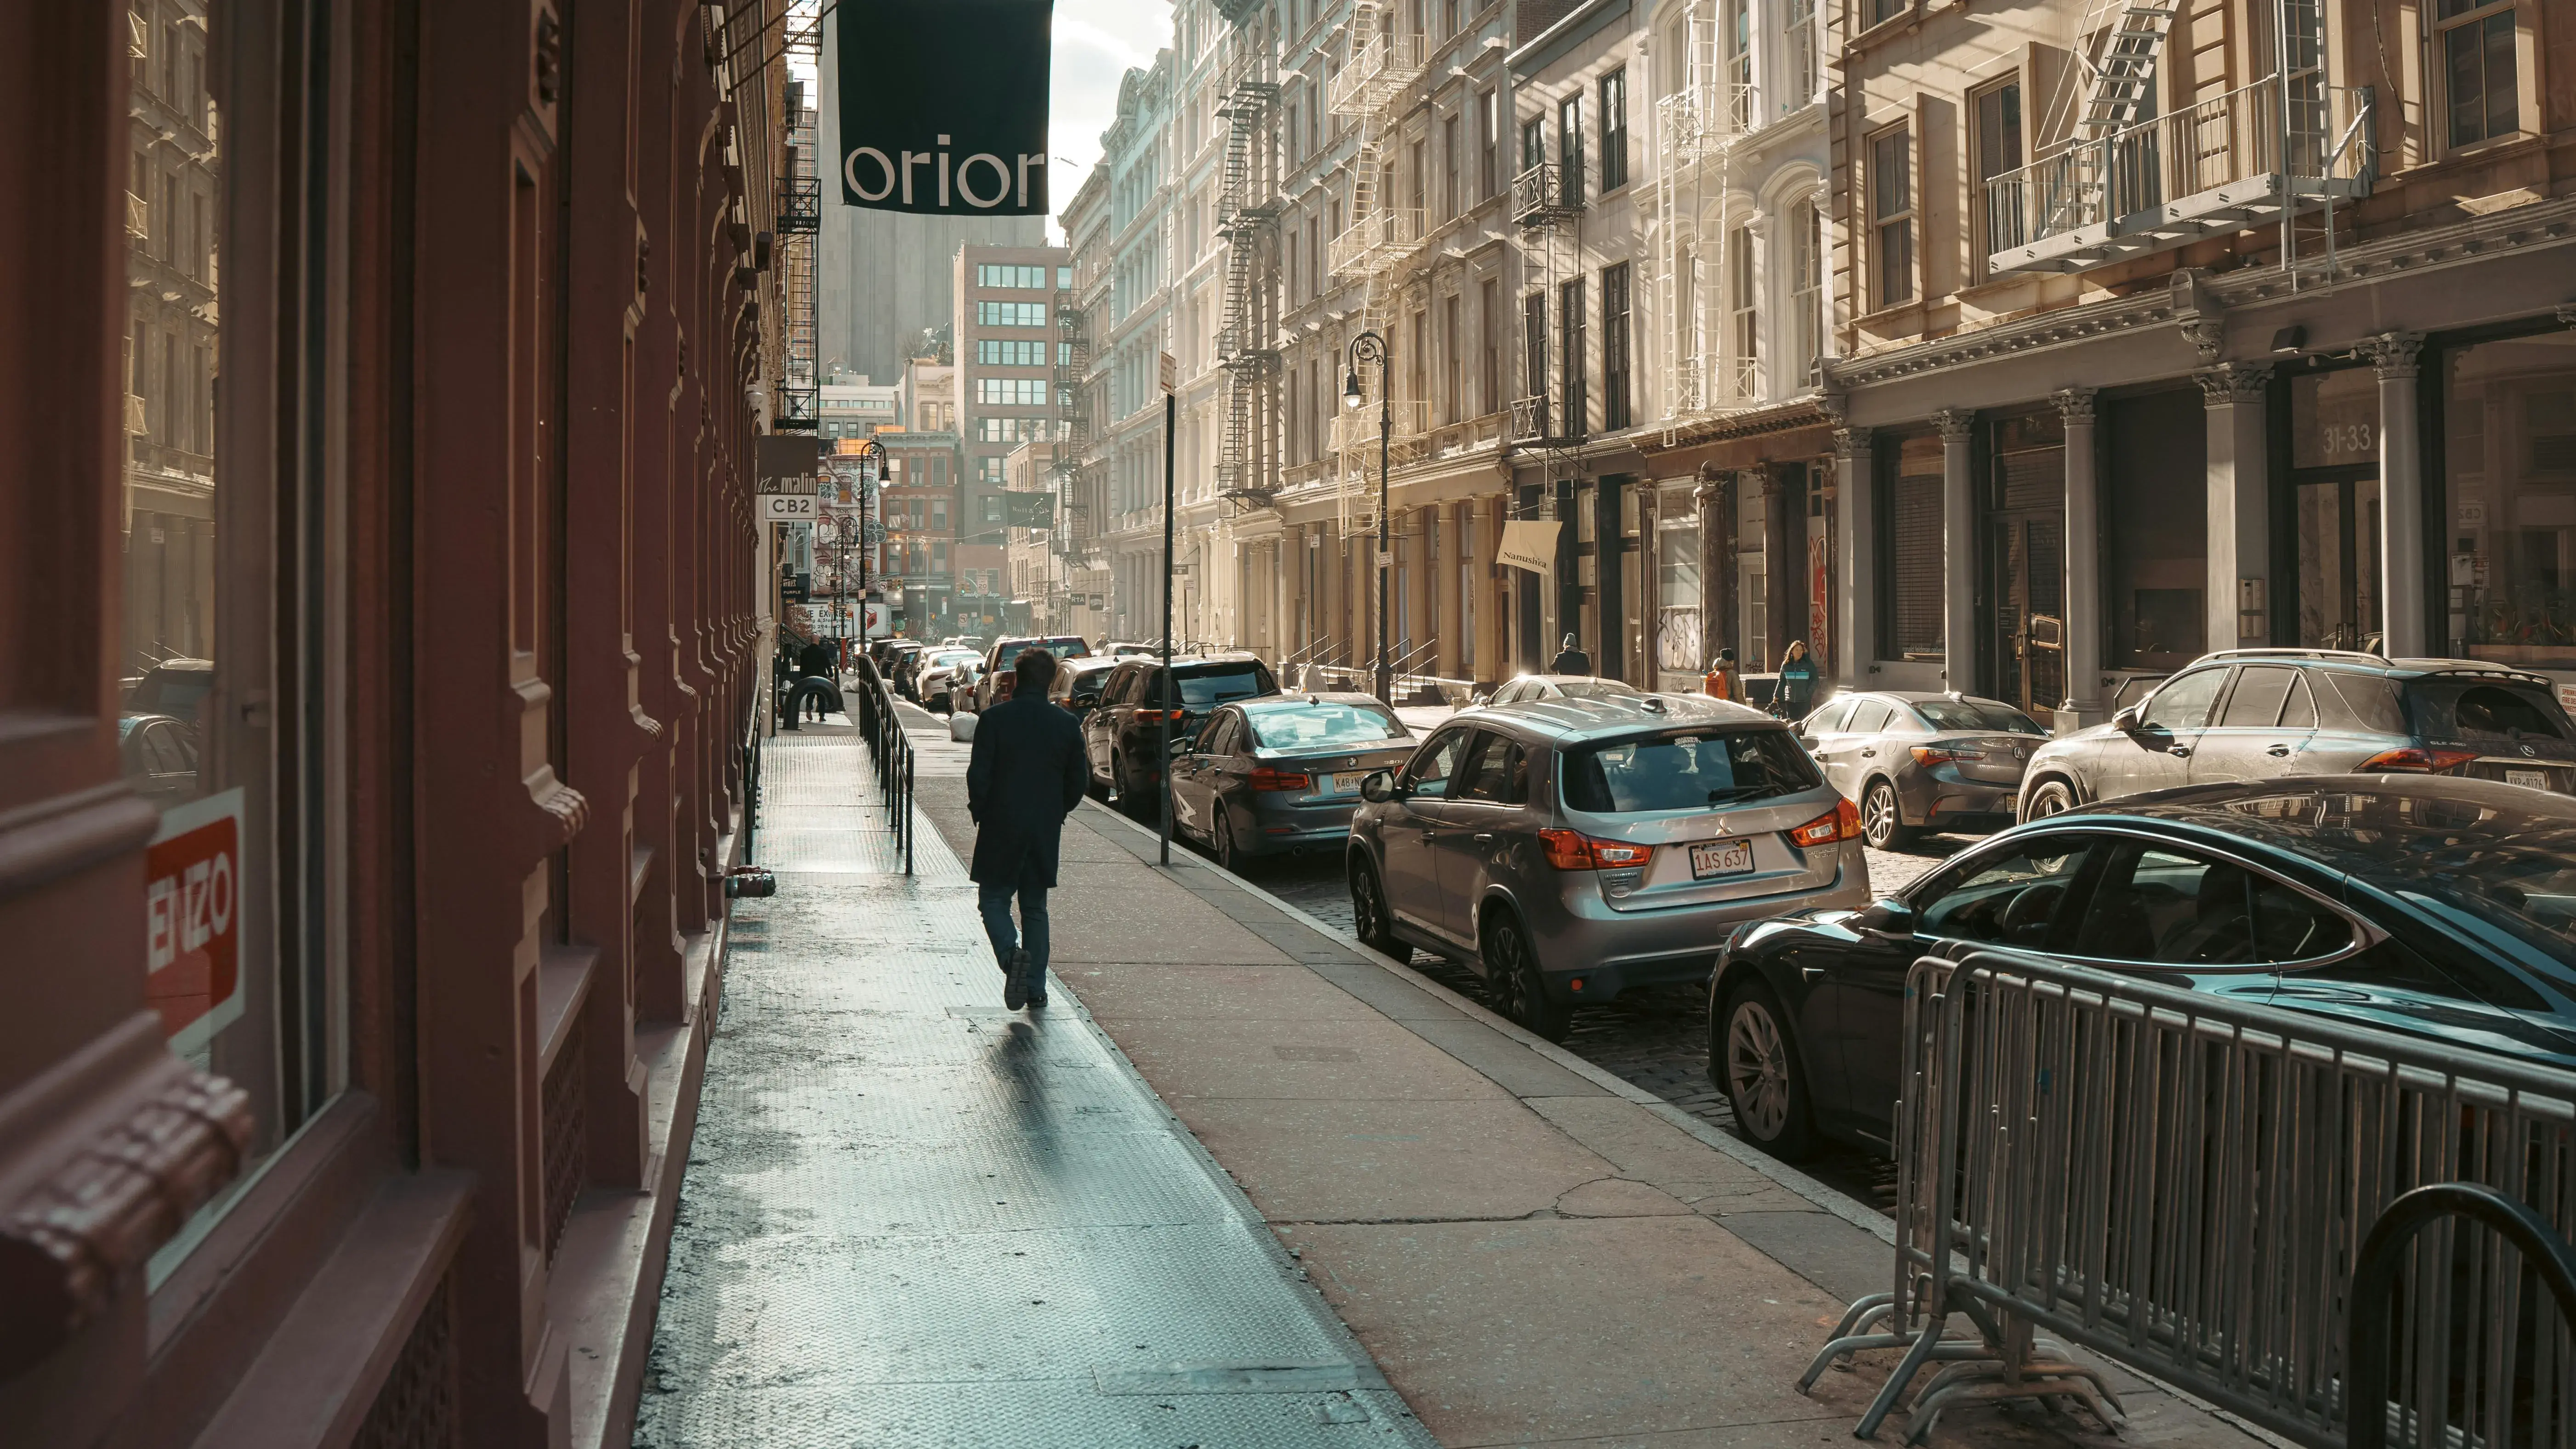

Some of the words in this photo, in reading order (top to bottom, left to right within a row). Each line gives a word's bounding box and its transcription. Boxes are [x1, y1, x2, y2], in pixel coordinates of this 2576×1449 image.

[845, 135, 1045, 208] orior
[2323, 424, 2371, 454] 31-33
[781, 472, 817, 494] malin
[772, 499, 810, 513] CB2
[1503, 551, 1547, 569] Nanushka
[1335, 777, 1350, 788] K48
[1695, 852, 1720, 871] 1AS
[1725, 849, 1748, 868] 637
[1604, 872, 1638, 881] MITSUBISHI
